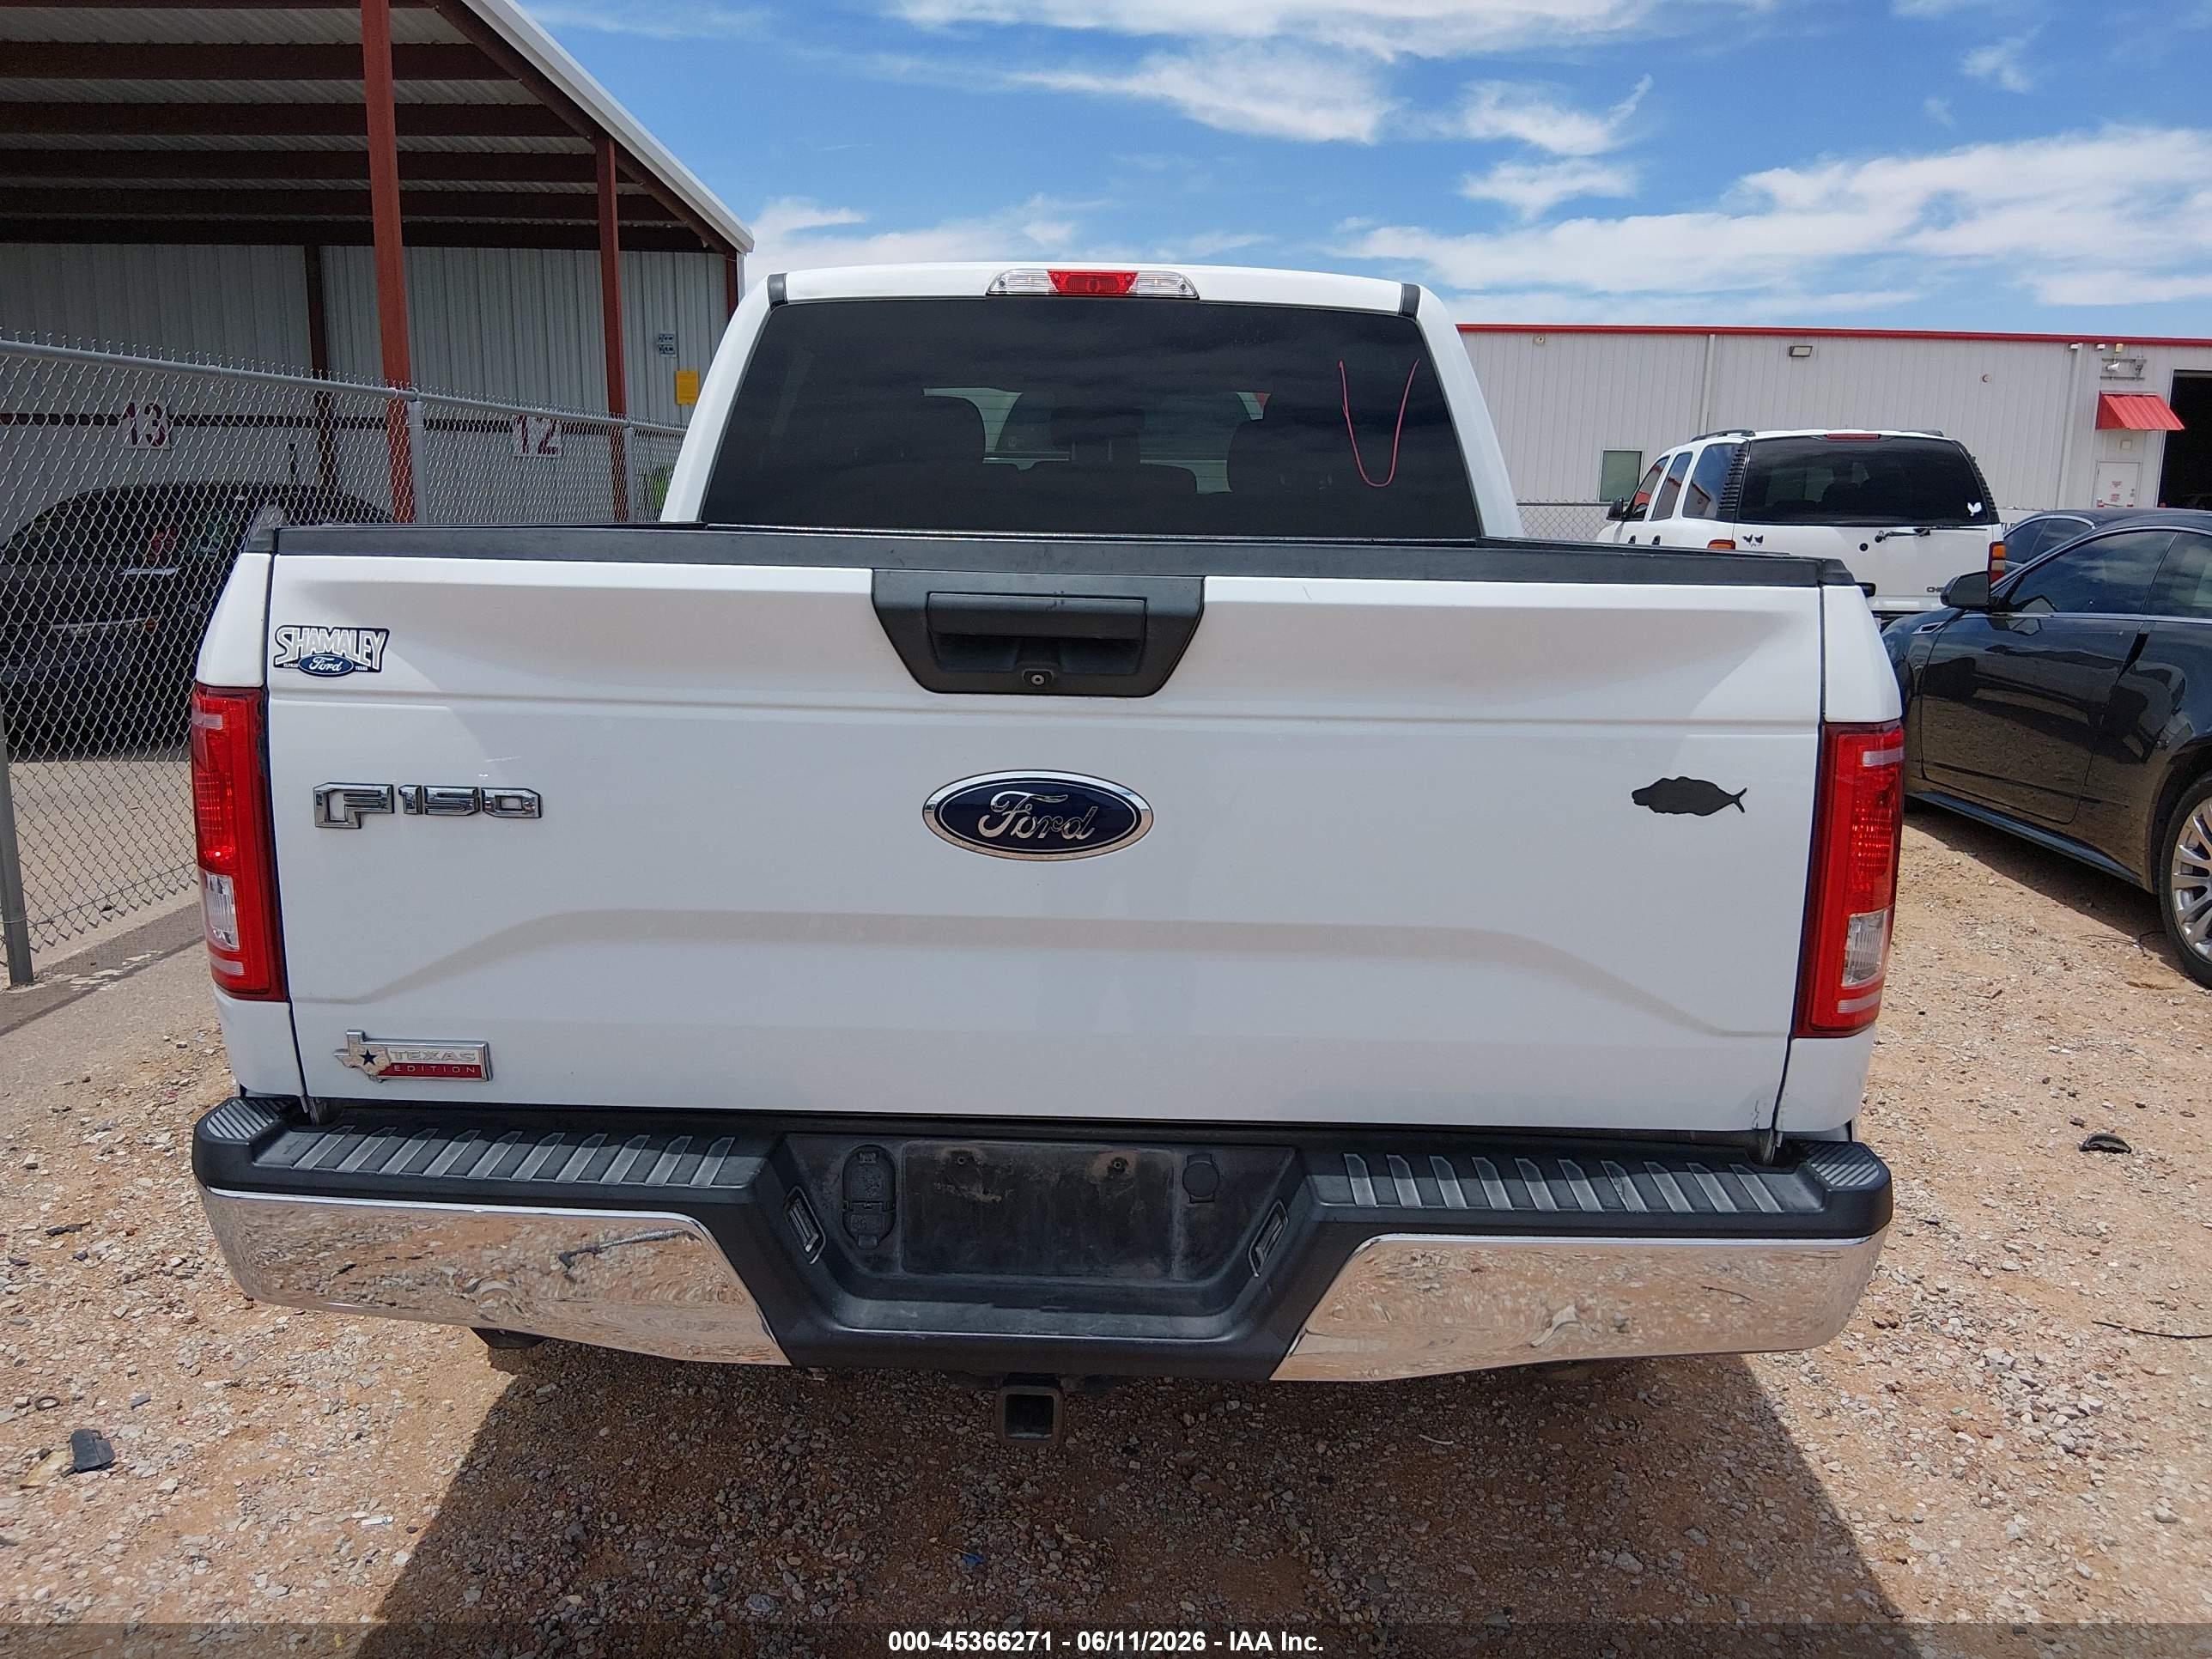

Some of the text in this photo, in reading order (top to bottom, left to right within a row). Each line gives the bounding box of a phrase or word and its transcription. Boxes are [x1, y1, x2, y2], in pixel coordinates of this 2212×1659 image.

[123, 403, 166, 447] 13
[515, 415, 558, 454] 12
[275, 627, 386, 670] SHAMALEY
[309, 656, 343, 672] Ford
[977, 790, 1098, 840] Ford
[390, 1050, 476, 1062] TEXAS
[393, 1065, 475, 1073] EDITION
